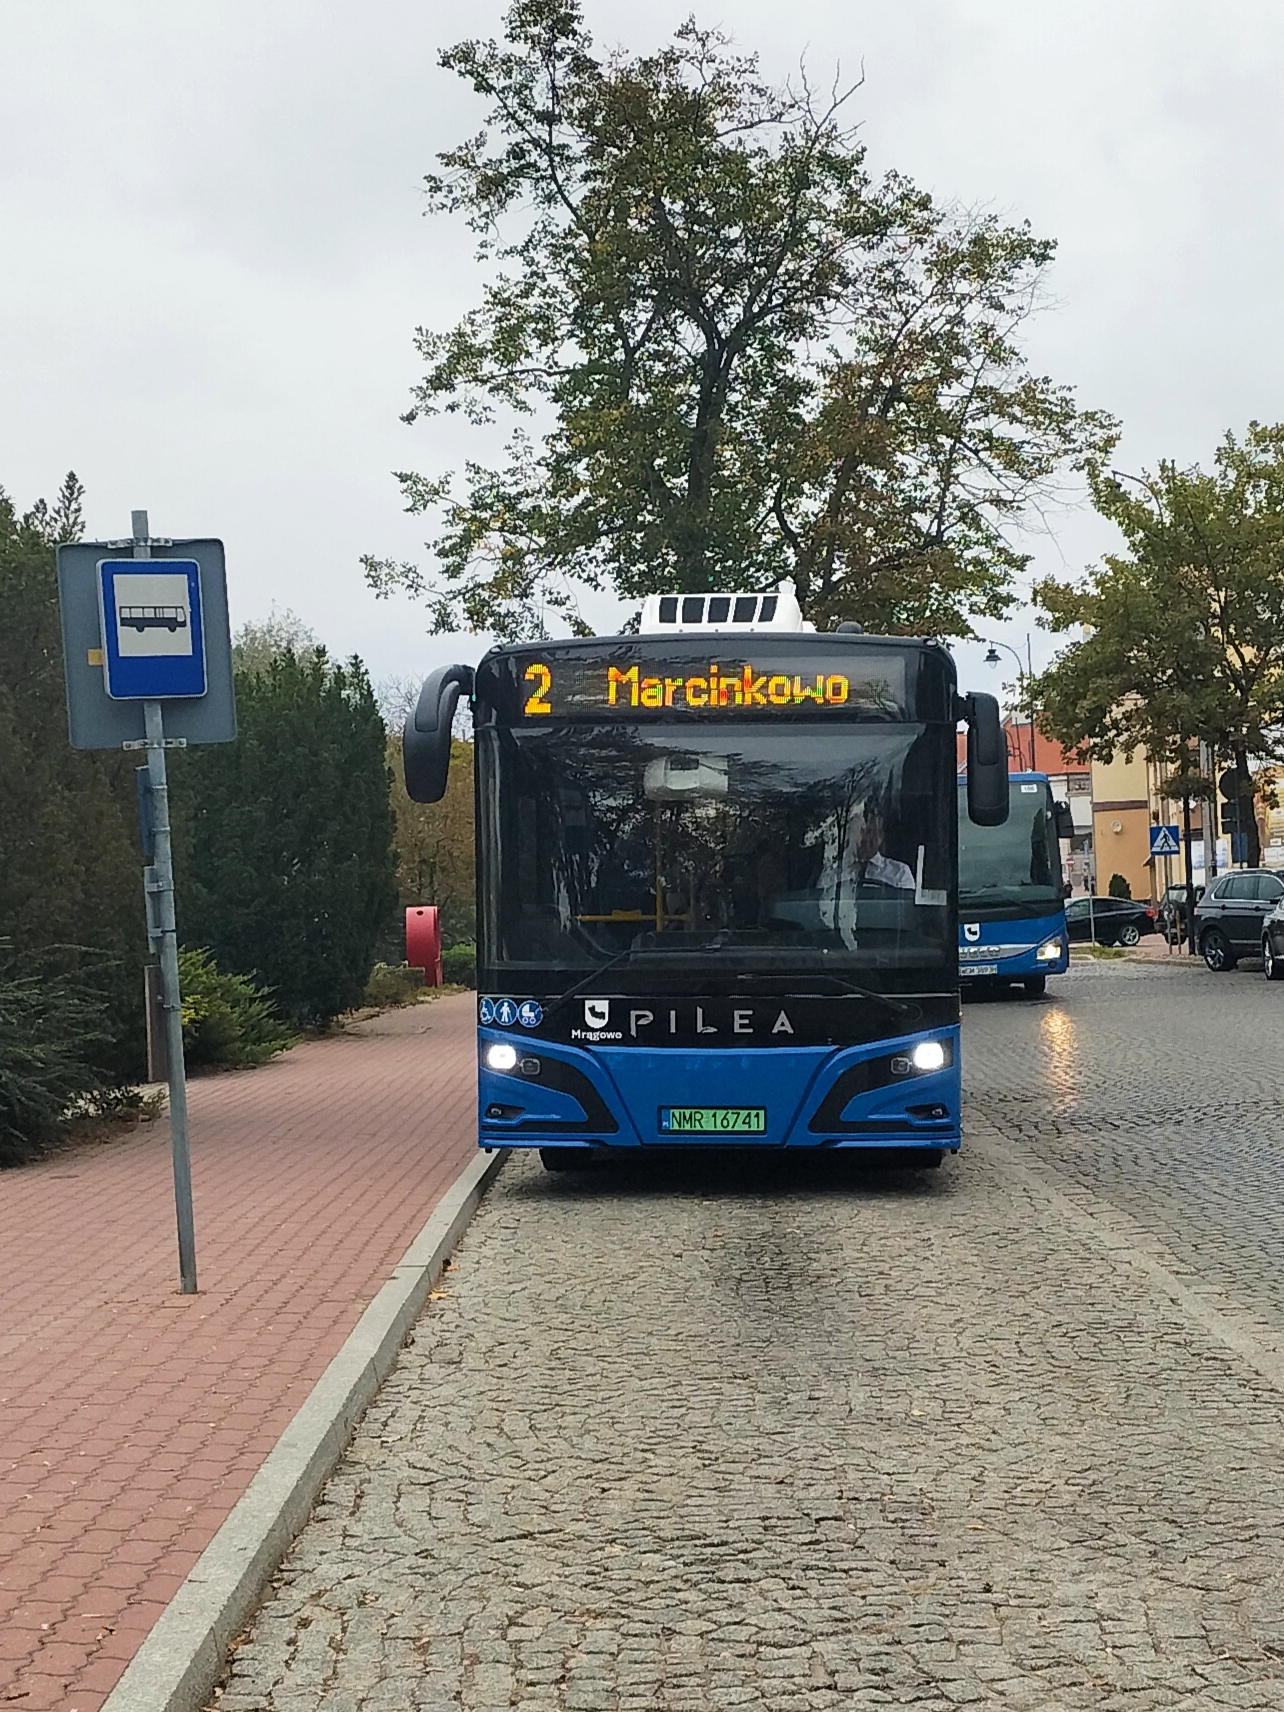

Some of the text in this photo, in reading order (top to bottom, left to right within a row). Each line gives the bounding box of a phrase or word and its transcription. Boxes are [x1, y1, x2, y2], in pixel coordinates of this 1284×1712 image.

[523, 663, 850, 714] 2 Marcinkowo
[571, 1028, 623, 1041] Mrągowo
[629, 1005, 795, 1038] PILEA
[671, 1110, 761, 1129] NMR 16741
